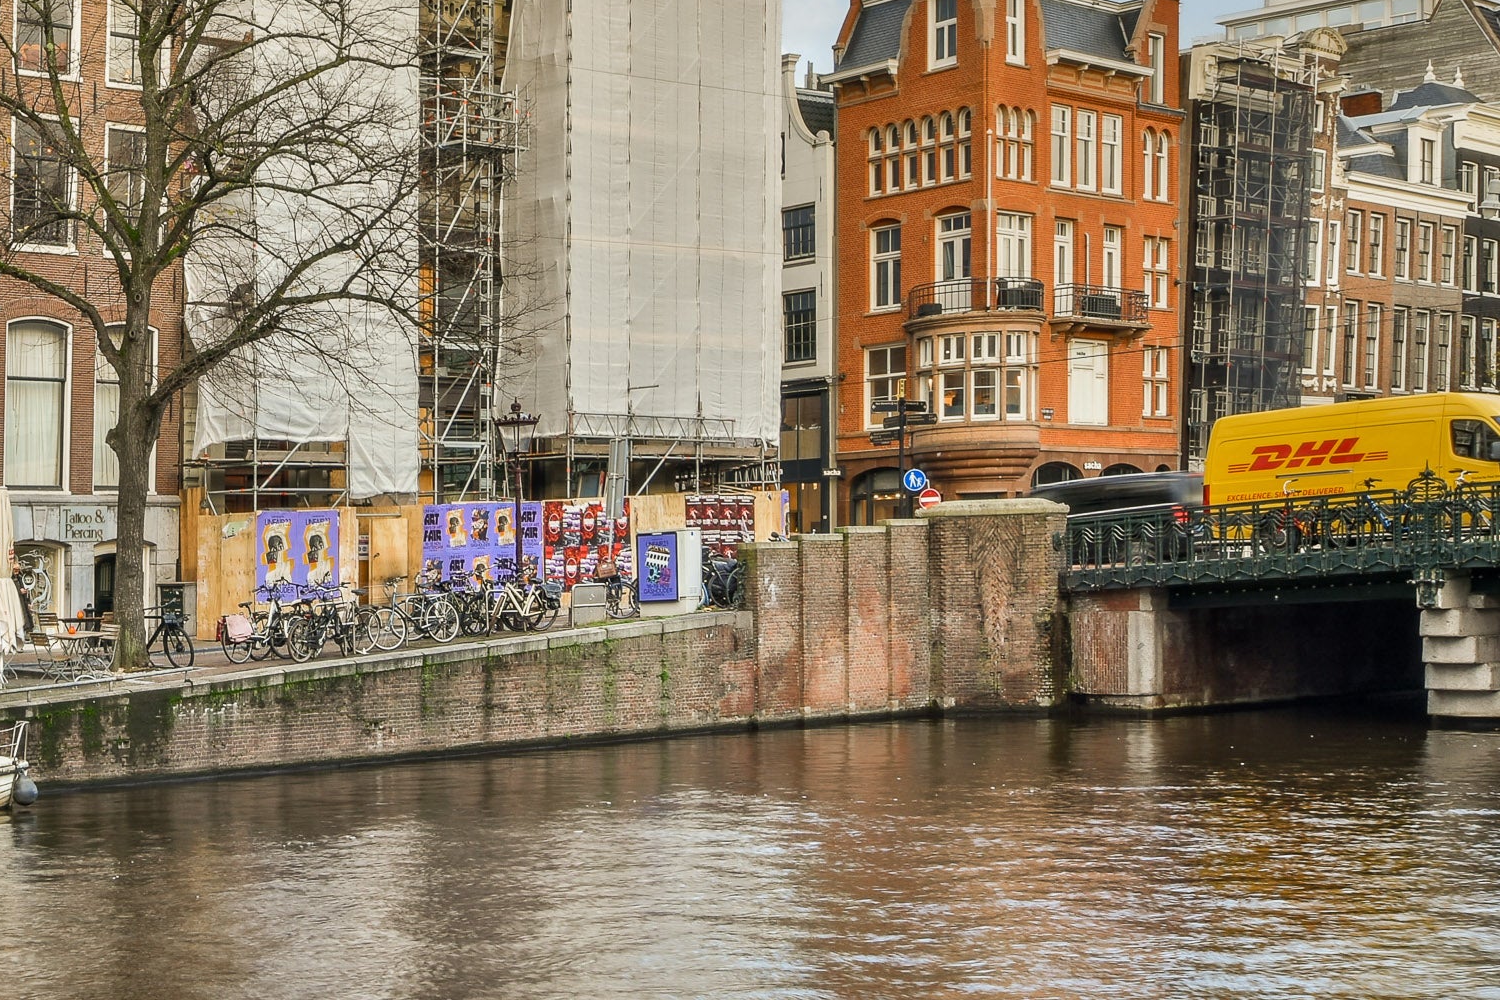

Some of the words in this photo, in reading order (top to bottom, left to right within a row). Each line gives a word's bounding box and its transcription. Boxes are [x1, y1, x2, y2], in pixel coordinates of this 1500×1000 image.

[1249, 437, 1366, 471] DHL
[1084, 461, 1102, 470] sacha
[62, 509, 92, 523] Tattoo
[95, 509, 106, 523] &
[424, 513, 439, 525] ART
[521, 511, 536, 522] ART
[65, 526, 103, 541] Piercing
[423, 529, 441, 542] FAIR
